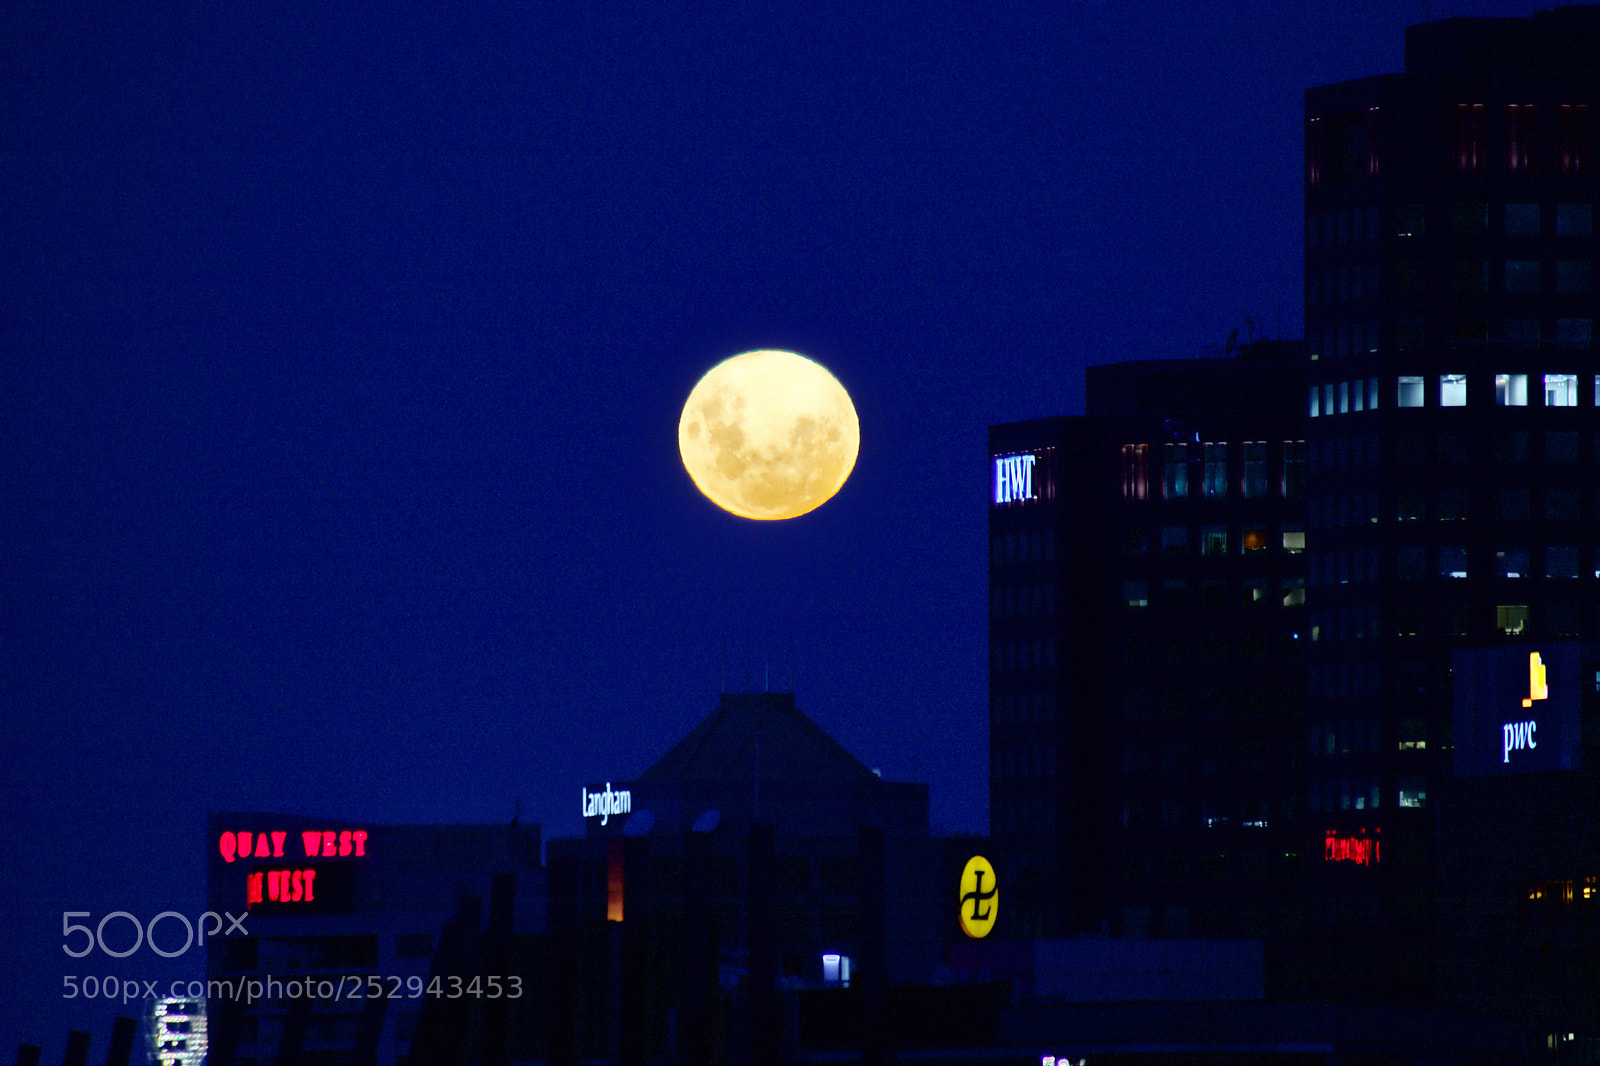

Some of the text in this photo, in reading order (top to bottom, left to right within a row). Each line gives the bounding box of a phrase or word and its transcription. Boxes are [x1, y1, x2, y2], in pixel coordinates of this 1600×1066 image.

[995, 454, 1036, 503] HWT
[1503, 720, 1537, 764] pwc
[582, 783, 631, 827] Langham
[219, 830, 369, 863] QUAY WEST
[267, 869, 317, 903] WEST
